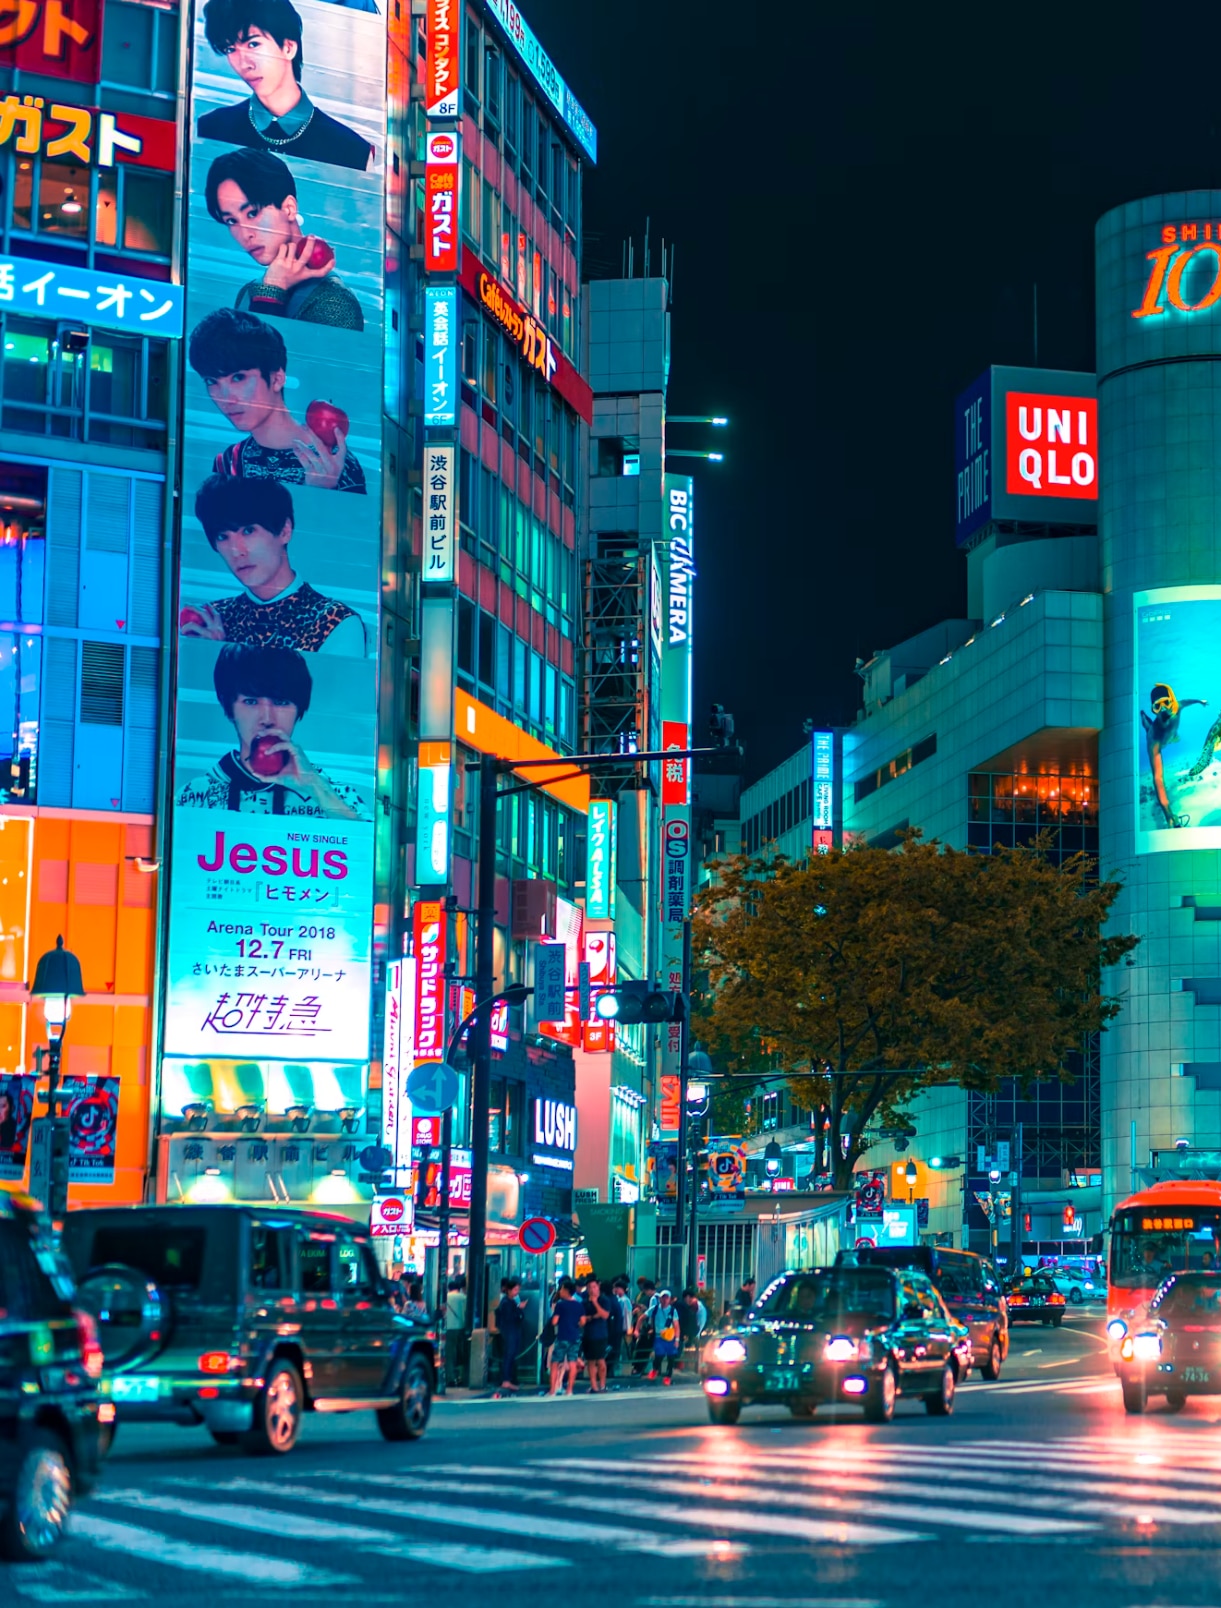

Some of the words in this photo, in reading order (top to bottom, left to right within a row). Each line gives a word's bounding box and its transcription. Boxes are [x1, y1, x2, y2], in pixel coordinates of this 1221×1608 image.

[434, 34, 450, 96] コンタクト
[438, 102, 457, 114] 8F
[0, 95, 141, 167] ガスト
[432, 145, 452, 153] ガスト
[430, 173, 453, 183] Café
[431, 191, 453, 257] ガスト
[479, 272, 501, 318] Café
[432, 300, 449, 346] 英会話
[522, 313, 557, 384] ガスト
[431, 346, 449, 412] イーオン
[432, 415, 446, 425] 6F
[963, 396, 983, 461] THE
[1018, 406, 1088, 446] UNI
[957, 448, 989, 522] PRIME
[1018, 447, 1096, 490] QLO
[429, 454, 448, 570] 渋谷駅前ビル
[669, 488, 688, 530] BIC
[669, 535, 697, 645] CAMERA
[816, 735, 830, 750] THE
[816, 752, 830, 779] PRIME
[196, 830, 348, 880] Jesus
[287, 832, 311, 843] NEW
[312, 833, 348, 845] SINGLE
[666, 820, 689, 858] OS
[667, 859, 685, 923] 調剤薬局
[206, 920, 254, 936] Arena
[259, 922, 294, 938] Tour
[298, 925, 336, 940] 2018
[235, 938, 285, 960] 12.7
[288, 948, 312, 961] FRI
[191, 961, 348, 983] さいたまスーパーアリーナ
[546, 948, 561, 1017] 渋谷駅前
[418, 945, 439, 1048] サンドラッグ
[589, 1031, 603, 1041] 3F
[534, 1098, 576, 1151] LUSH
[382, 1208, 403, 1216] ガスト
[575, 1190, 597, 1199] LUSH
